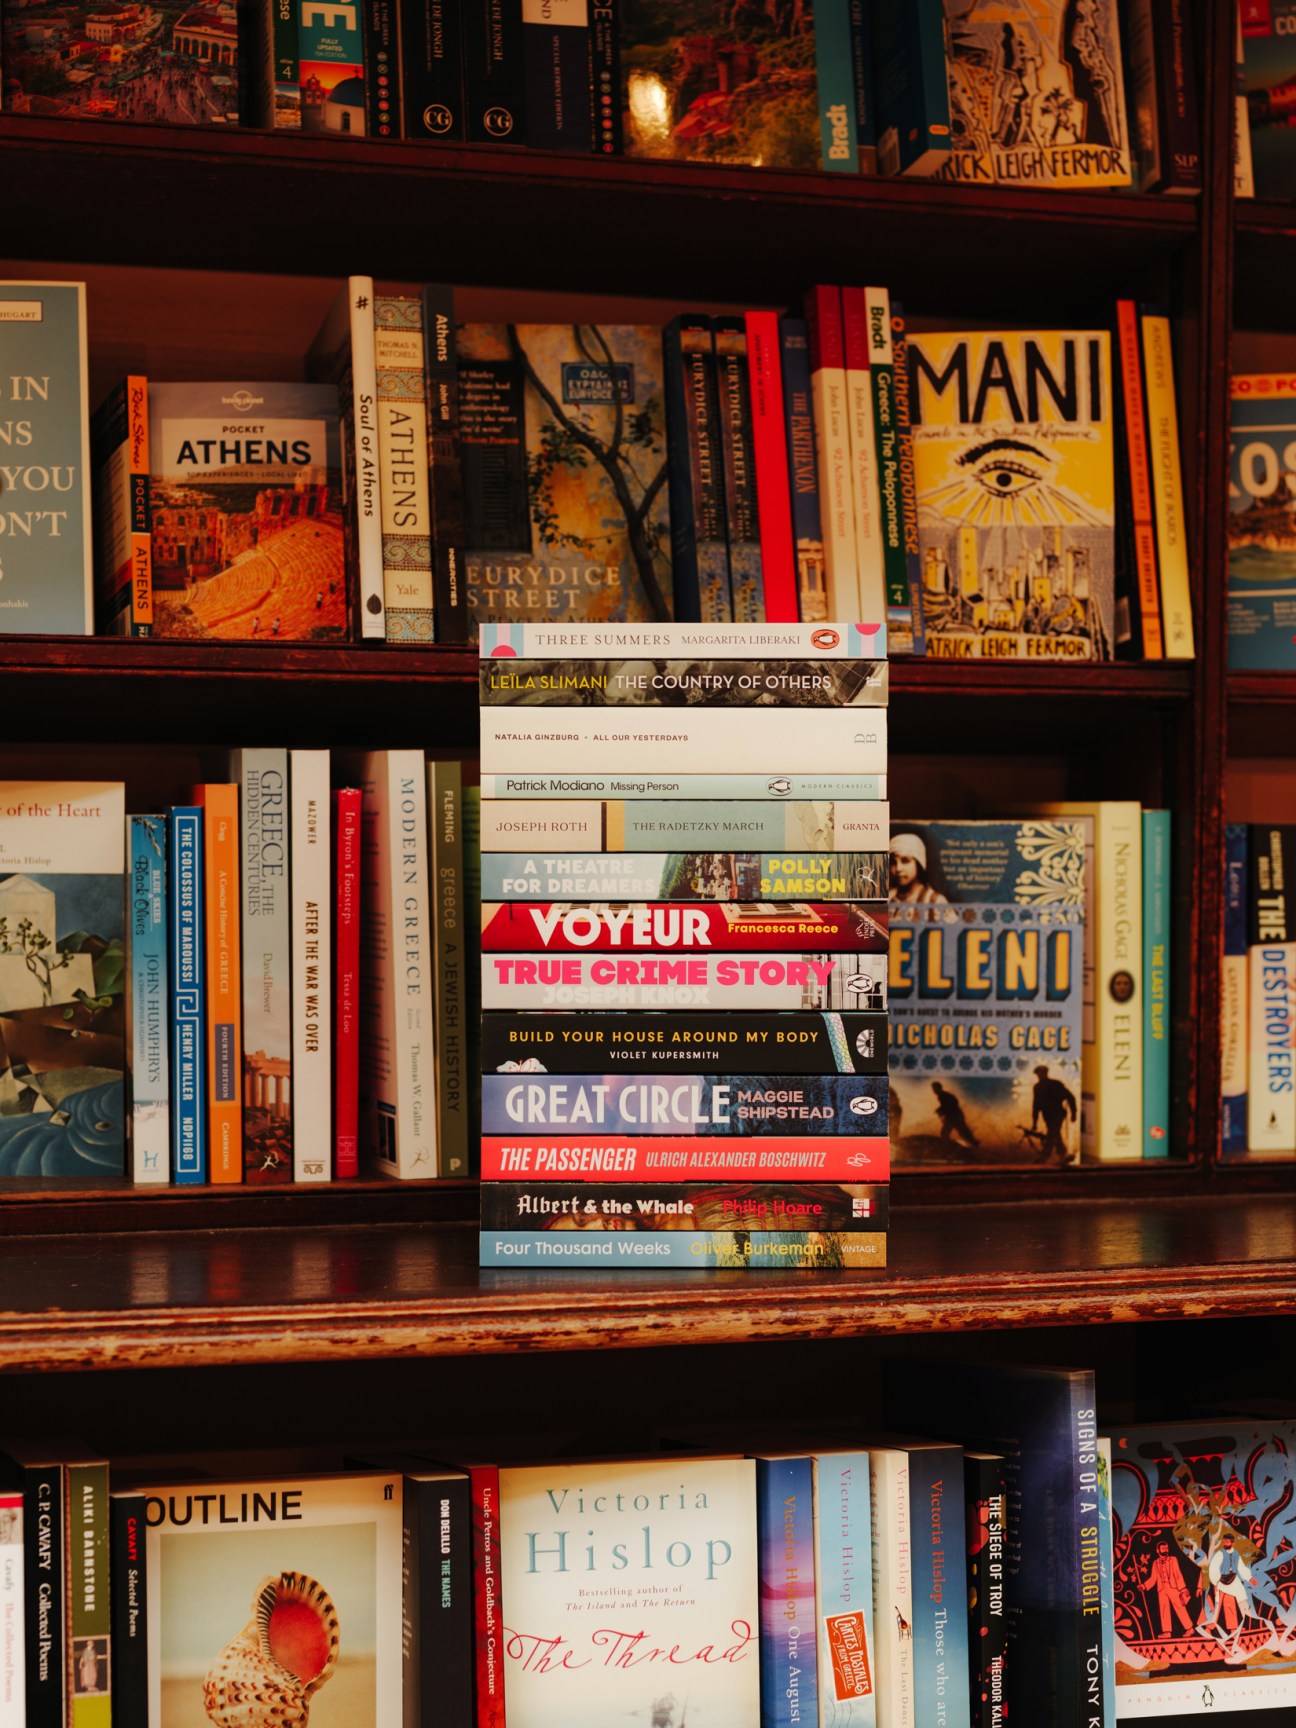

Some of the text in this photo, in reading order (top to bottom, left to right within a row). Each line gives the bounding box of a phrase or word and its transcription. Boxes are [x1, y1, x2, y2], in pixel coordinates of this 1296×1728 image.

[826, 104, 850, 160] Bradt
[996, 148, 1128, 179] LEIGH FERMOR
[435, 314, 450, 362] Athens
[870, 306, 887, 349] Bradt
[10, 376, 50, 401] IN
[908, 339, 1100, 425] MANI
[222, 425, 265, 434] POCKET
[692, 353, 712, 486] EURYDICE STREET
[176, 440, 312, 465] ATHENS
[360, 394, 377, 517] Soul of Athens
[791, 415, 816, 493] PARTHENON
[881, 429, 895, 458] The
[3, 467, 75, 491] YOU
[389, 409, 417, 527] ATHENS
[135, 479, 146, 530] POCKET
[882, 460, 899, 549] Peloponnese
[136, 547, 149, 610] ATHENS
[467, 566, 621, 586] EURYDICE
[396, 584, 419, 596] Yale
[467, 589, 580, 609] STREET
[535, 634, 801, 645] THREE SUMMERS MARGARITA LIBERAKI
[980, 638, 1086, 656] LEIGH FERMOR
[490, 673, 832, 689] LEÏLA SLIMANI THE COUNTRY OF OTHERS
[494, 733, 532, 741] NATALIA
[534, 733, 580, 741] GINZBURG
[506, 780, 679, 793] Patrick Modiano Missing Person
[6, 803, 102, 817] of the Heart
[496, 822, 880, 832] JOSEPH ROTH THE RADETZKY MARCH GRANTA
[523, 859, 634, 874] A THEATRE
[768, 859, 832, 874] POLLY
[401, 778, 420, 996] MODERN GREECE
[502, 878, 656, 894] FOR DREAMERS
[760, 878, 846, 893] SAMSON
[529, 908, 712, 947] VOYEUR
[728, 923, 839, 933] Francesca Reece
[1258, 895, 1286, 940] THE
[440, 790, 460, 1112] FLEMING greece A JEWISH HISTORY
[181, 827, 193, 1101] THE COLOSSUS OF MAROUSSI HENRY MILLER
[305, 901, 319, 1052] AFTER THE WAR WAS OVER
[494, 960, 837, 985] TRUE CRIME STORY
[542, 986, 711, 1004] JOSEPH KNOX
[1262, 949, 1293, 1094] DESTROYERS
[509, 1031, 819, 1042] BUILD YOUR HOUSE AROUND MY BODY
[1010, 1026, 1071, 1049] GAGE
[609, 1051, 719, 1059] VIOLET KUPERSMITH
[505, 1085, 731, 1123] GREAT CIRCLE
[737, 1090, 804, 1103] MAGGIE
[737, 1106, 835, 1119] SHIPSTEAD
[500, 1148, 827, 1171] THE PASSENGER ULRICH ALEXANDER BOSCHWITZ
[516, 1194, 823, 1217] Albert & the Whale Philip Hoare
[495, 1241, 876, 1255] Four Thousand Weeks Oliver Burkeman VINTAGE
[145, 1491, 303, 1527] OUTLINE
[546, 1484, 709, 1514] Victoria
[1077, 1409, 1100, 1616] SIGNS OF A STRUGGLE
[83, 1485, 95, 1612] ALIKI BARNSTONE
[440, 1499, 451, 1608] DON DELILLO THE NAMES
[524, 1525, 732, 1580] Hislop
[929, 1479, 946, 1604] Victoria Hislop
[989, 1494, 1003, 1616] THE SIEGE OF TROY
[578, 1584, 683, 1597] Bestselling author of
[565, 1597, 696, 1611] The Island and The Return
[502, 1620, 758, 1673] The Thread
